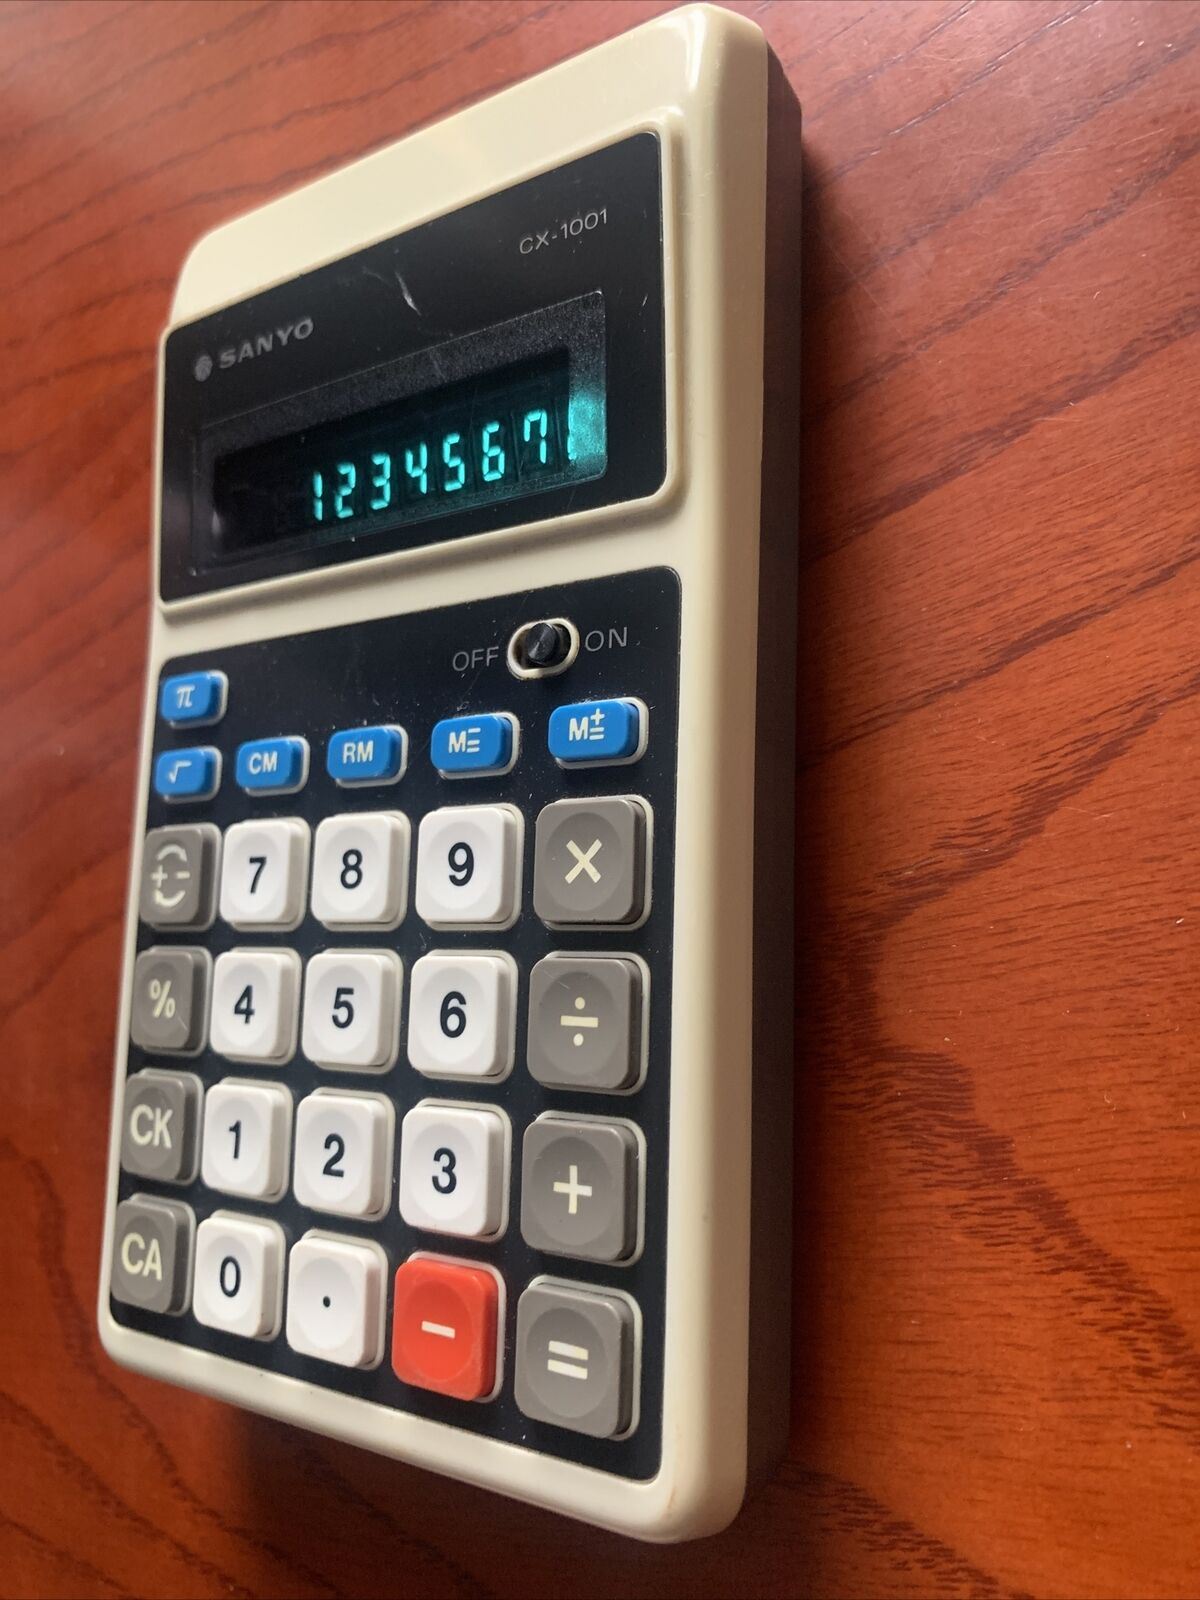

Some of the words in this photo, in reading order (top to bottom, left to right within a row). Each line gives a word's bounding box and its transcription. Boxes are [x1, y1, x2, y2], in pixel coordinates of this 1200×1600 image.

[519, 208, 608, 254] CX-1001
[218, 318, 315, 369] SANYO
[452, 647, 499, 672] OFF
[585, 627, 628, 653] ON
[248, 752, 278, 774] CM
[342, 741, 374, 764] RM
[248, 856, 267, 895] 7
[340, 849, 363, 890] 8
[447, 842, 475, 886] 9
[150, 979, 175, 1018] %
[233, 985, 255, 1024] 4
[331, 988, 355, 1029] 5
[440, 991, 467, 1038] 6
[130, 1104, 172, 1149] CK
[228, 1121, 242, 1160] 1
[323, 1134, 346, 1178] 2
[432, 1147, 457, 1194] 3
[553, 1165, 593, 1214] +
[121, 1234, 163, 1281] CA
[219, 1256, 241, 1298] 0
[548, 1341, 588, 1379] =
